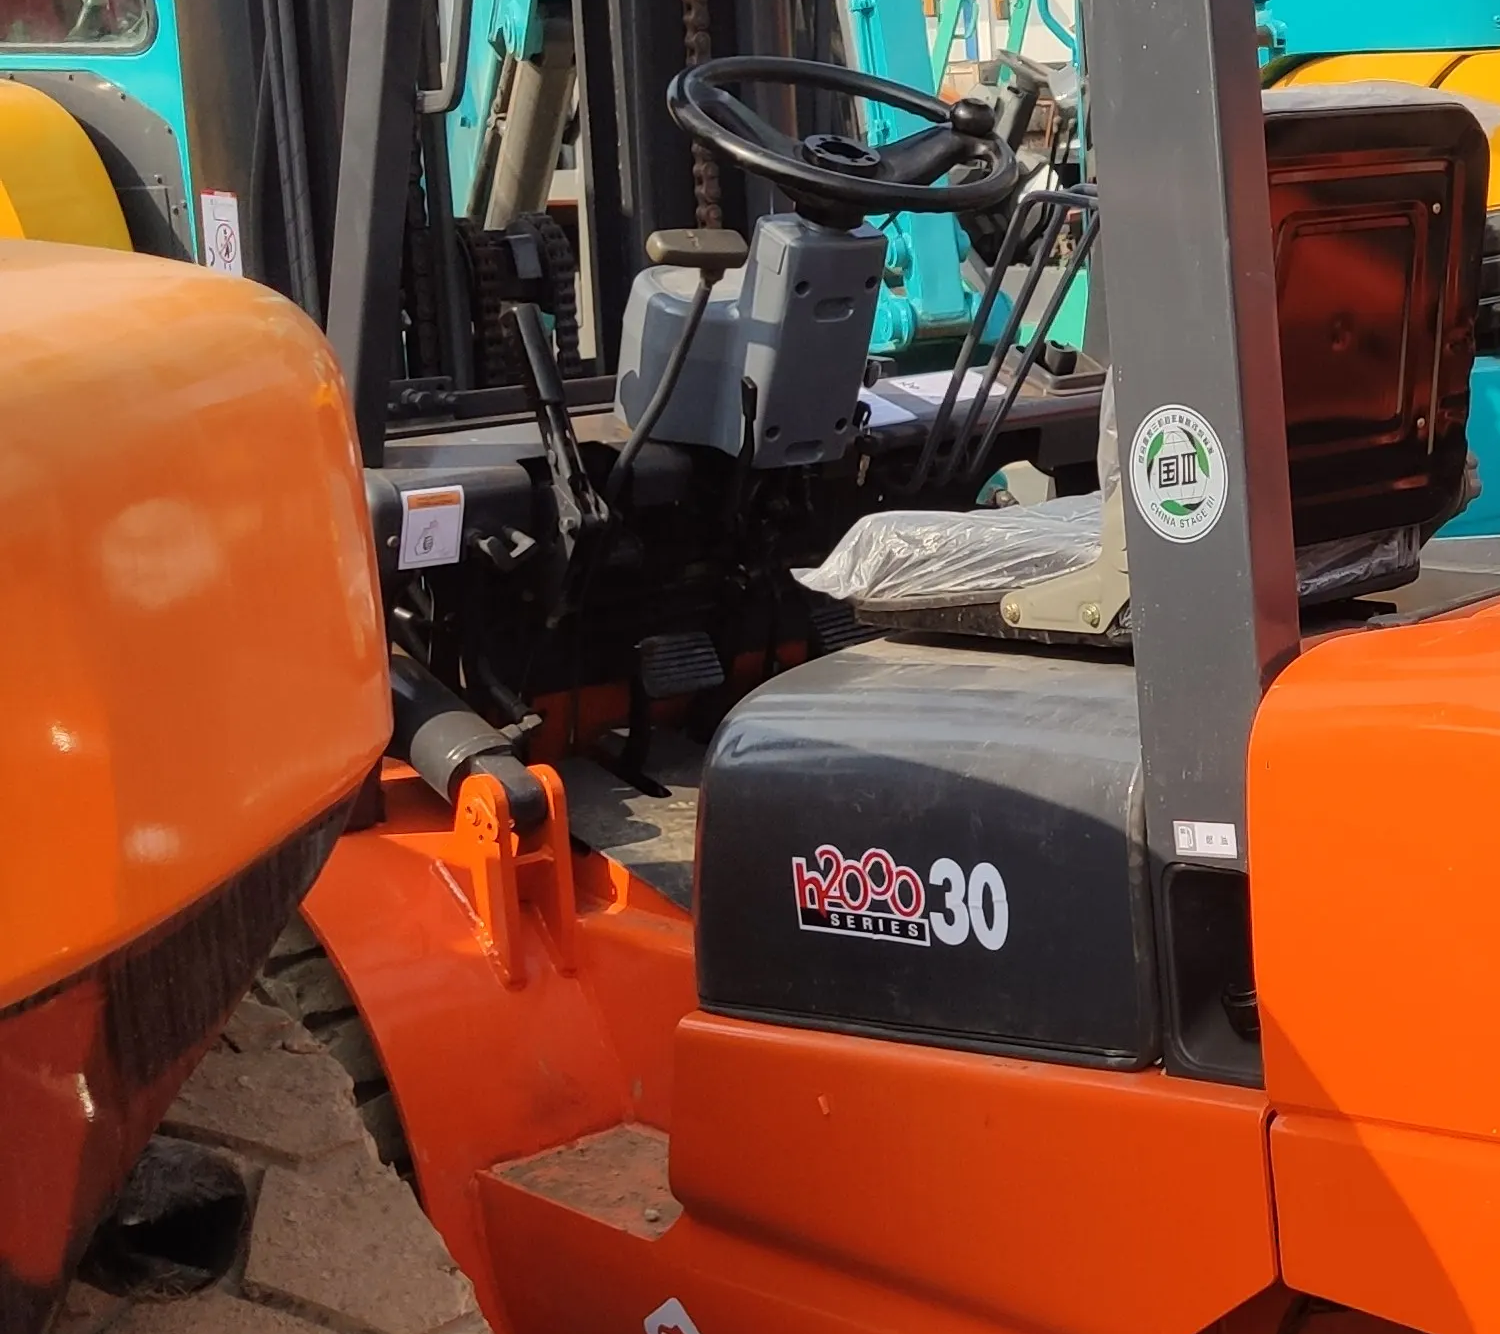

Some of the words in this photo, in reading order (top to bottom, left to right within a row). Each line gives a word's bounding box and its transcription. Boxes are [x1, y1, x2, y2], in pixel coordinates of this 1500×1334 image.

[1150, 502, 1176, 527] CHINA
[1180, 510, 1208, 528] STAGE
[929, 857, 1009, 951] 30
[831, 913, 919, 938] SERIES
